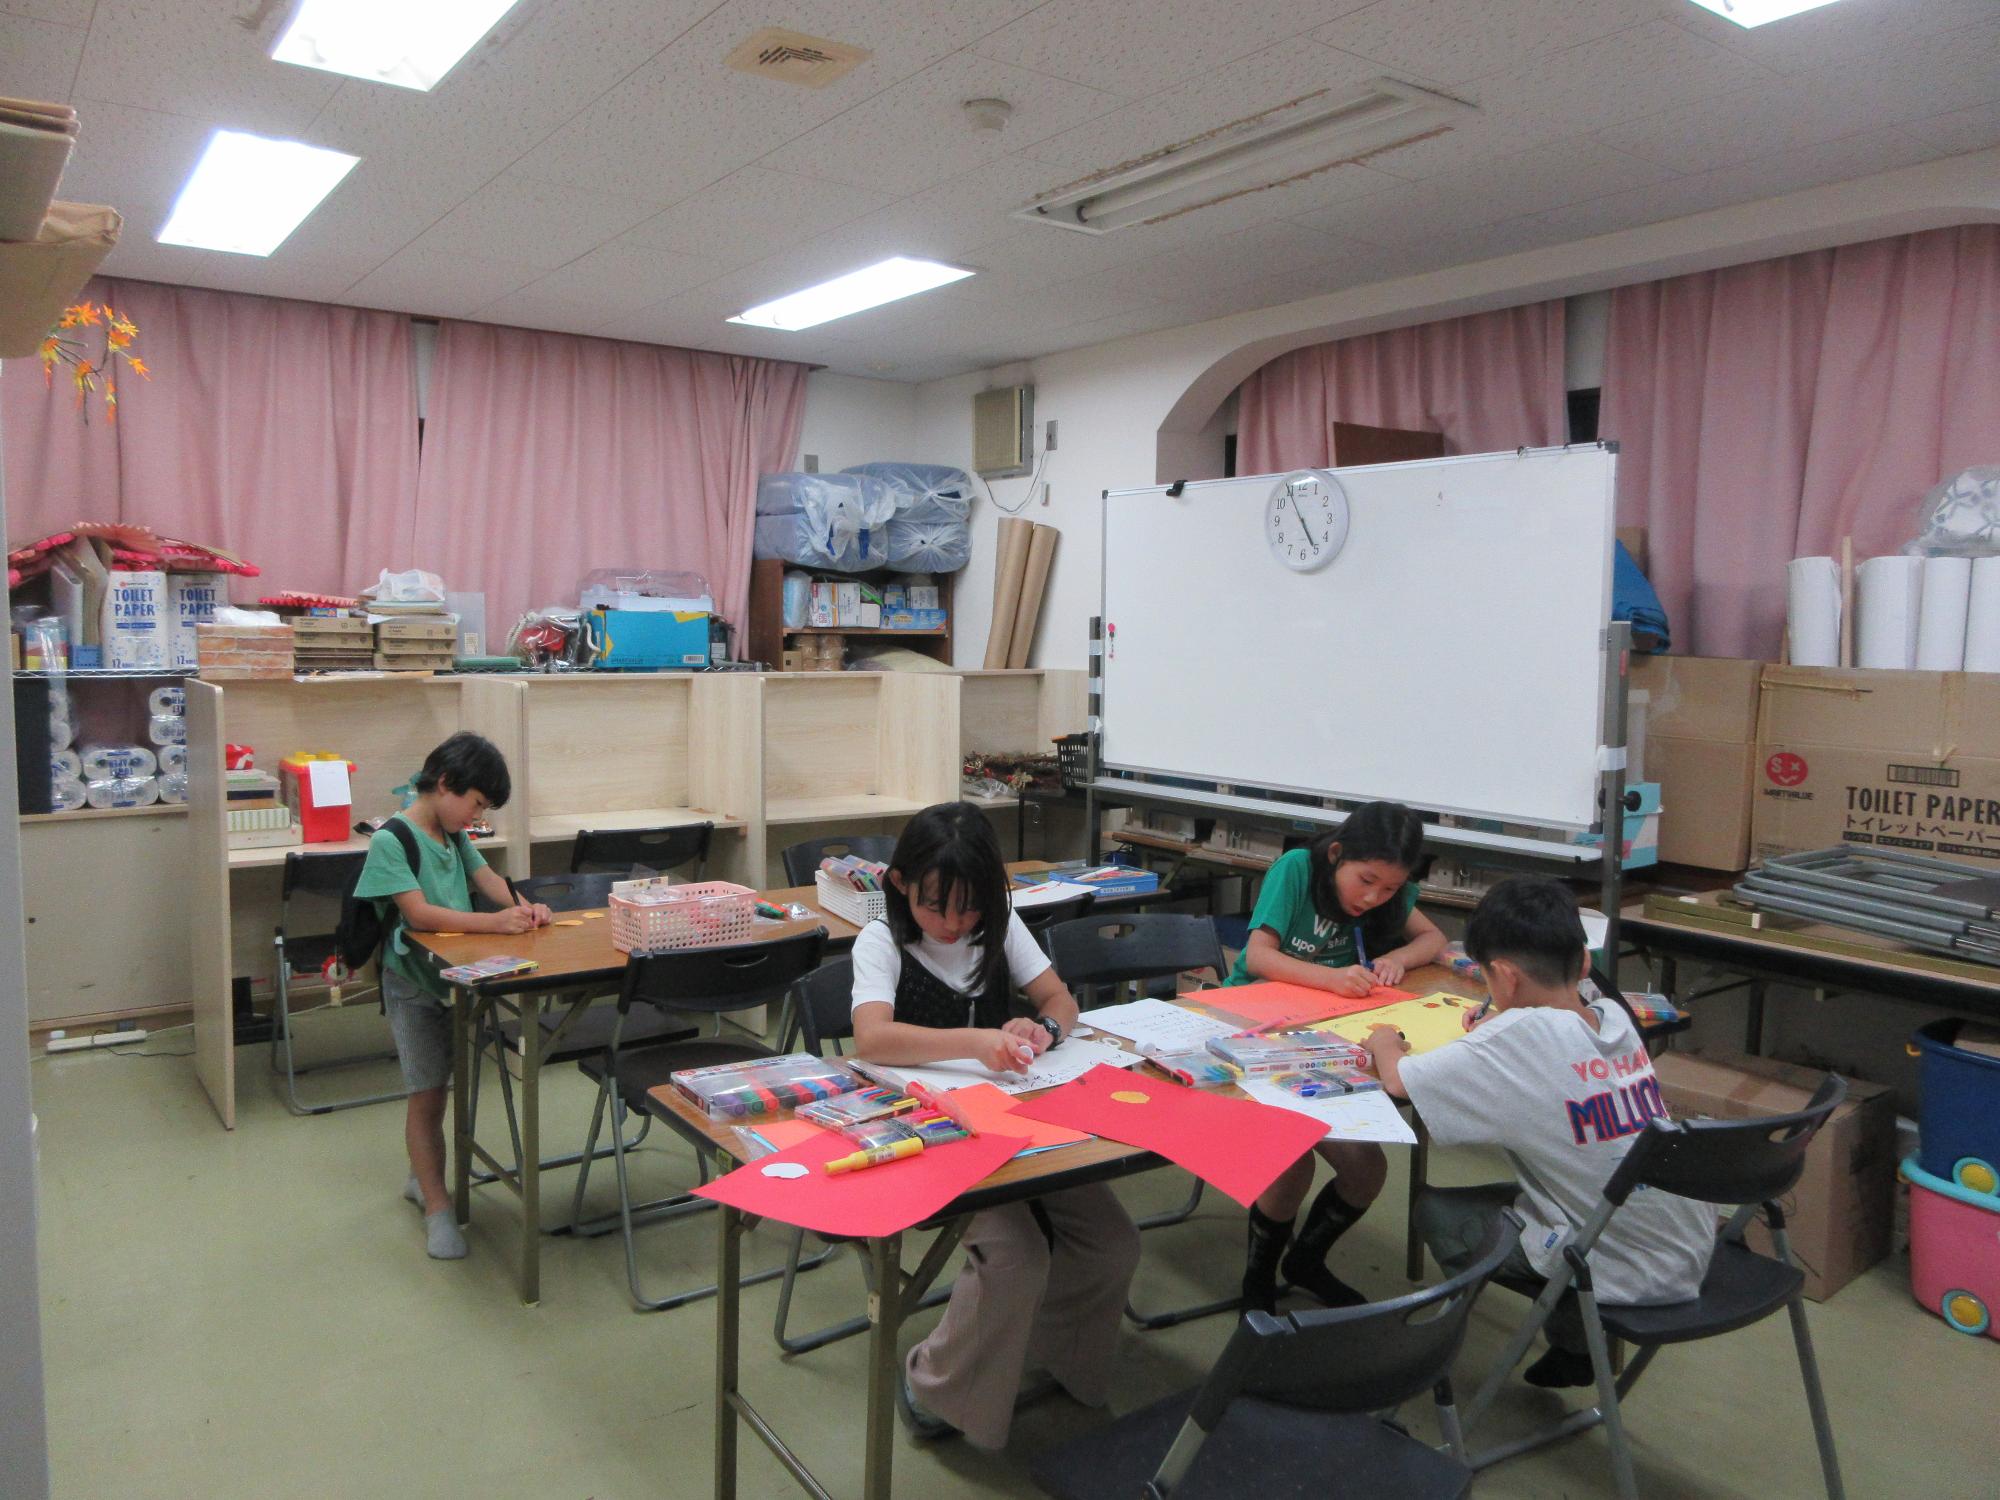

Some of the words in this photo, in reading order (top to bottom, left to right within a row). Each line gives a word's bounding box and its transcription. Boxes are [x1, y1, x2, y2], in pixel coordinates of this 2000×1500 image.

[1276, 498, 1286, 510] 10
[1323, 496, 1329, 507] 2
[1274, 516, 1280, 526] 9
[1327, 513, 1333, 524] 3
[1278, 533, 1284, 543] 8
[1323, 531, 1329, 542] 4
[1287, 544, 1293, 555] 7
[1300, 549, 1306, 560] 6
[1313, 544, 1319, 555] 5
[113, 589, 154, 601] TOILET
[179, 589, 216, 601] TOILET
[114, 604, 156, 616] PAPER
[112, 659, 121, 668] 12
[177, 655, 185, 665] 12
[1846, 786, 1917, 817] TOILET
[1926, 793, 2000, 826] PAPER
